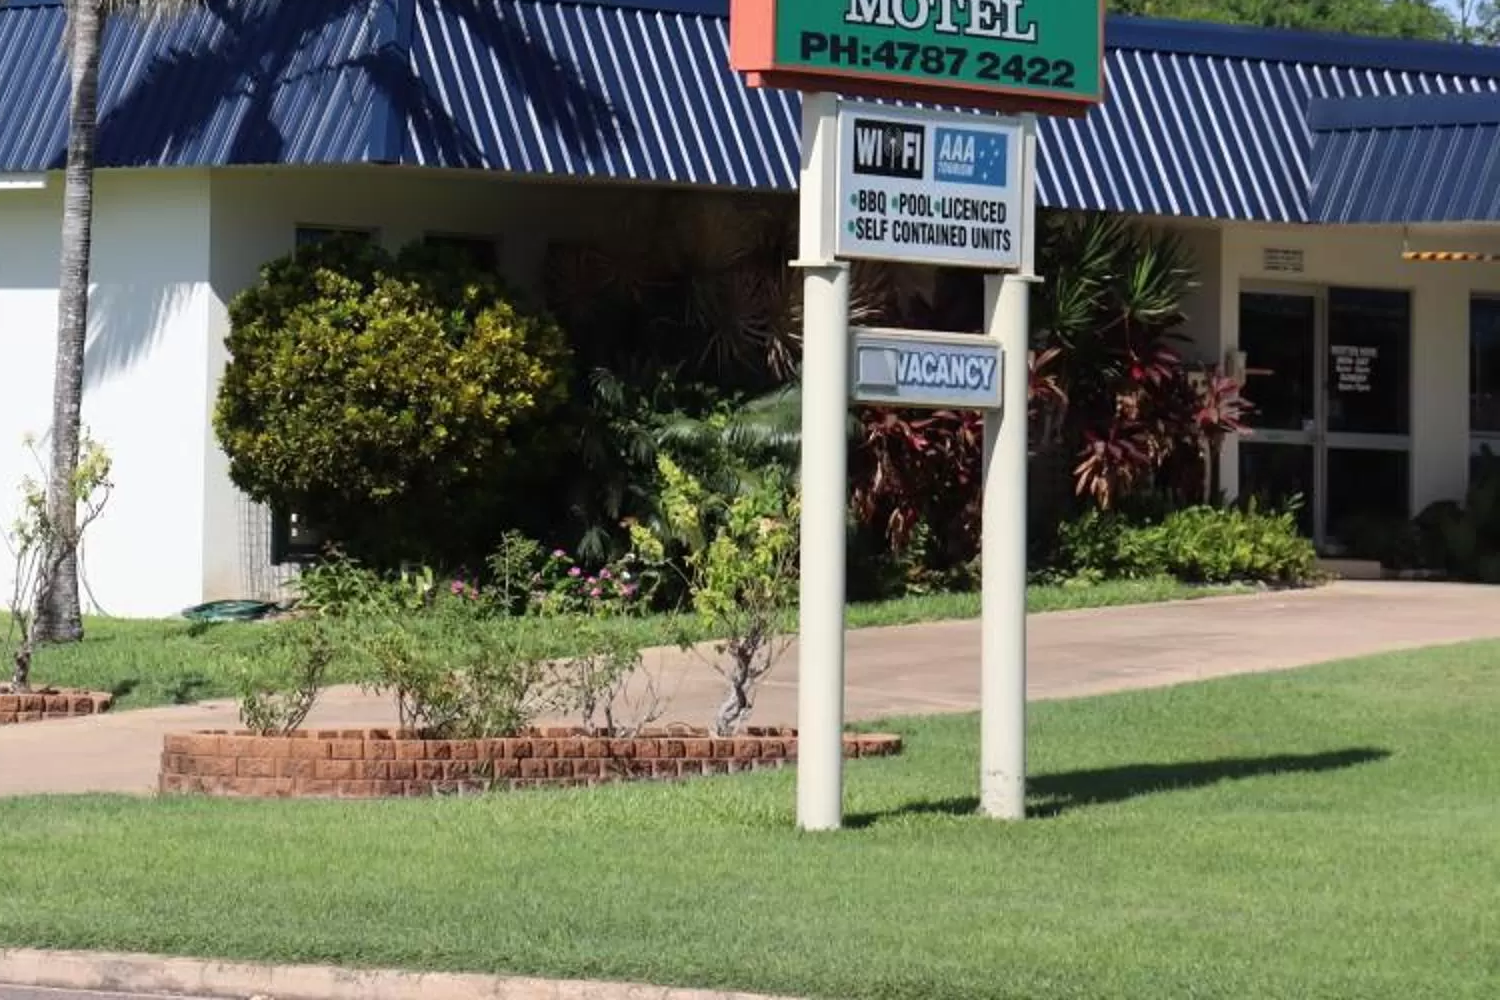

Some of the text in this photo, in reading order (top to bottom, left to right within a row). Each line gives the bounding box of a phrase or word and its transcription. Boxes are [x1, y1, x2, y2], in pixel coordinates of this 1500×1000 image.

[801, 32, 1075, 88] PH:4787 2422
[940, 133, 975, 162] AAA
[858, 190, 1007, 224] BBQ POOL LICENCED
[855, 217, 1011, 252] SELF CONTAINED UNITS
[898, 351, 997, 391] VACANCY
